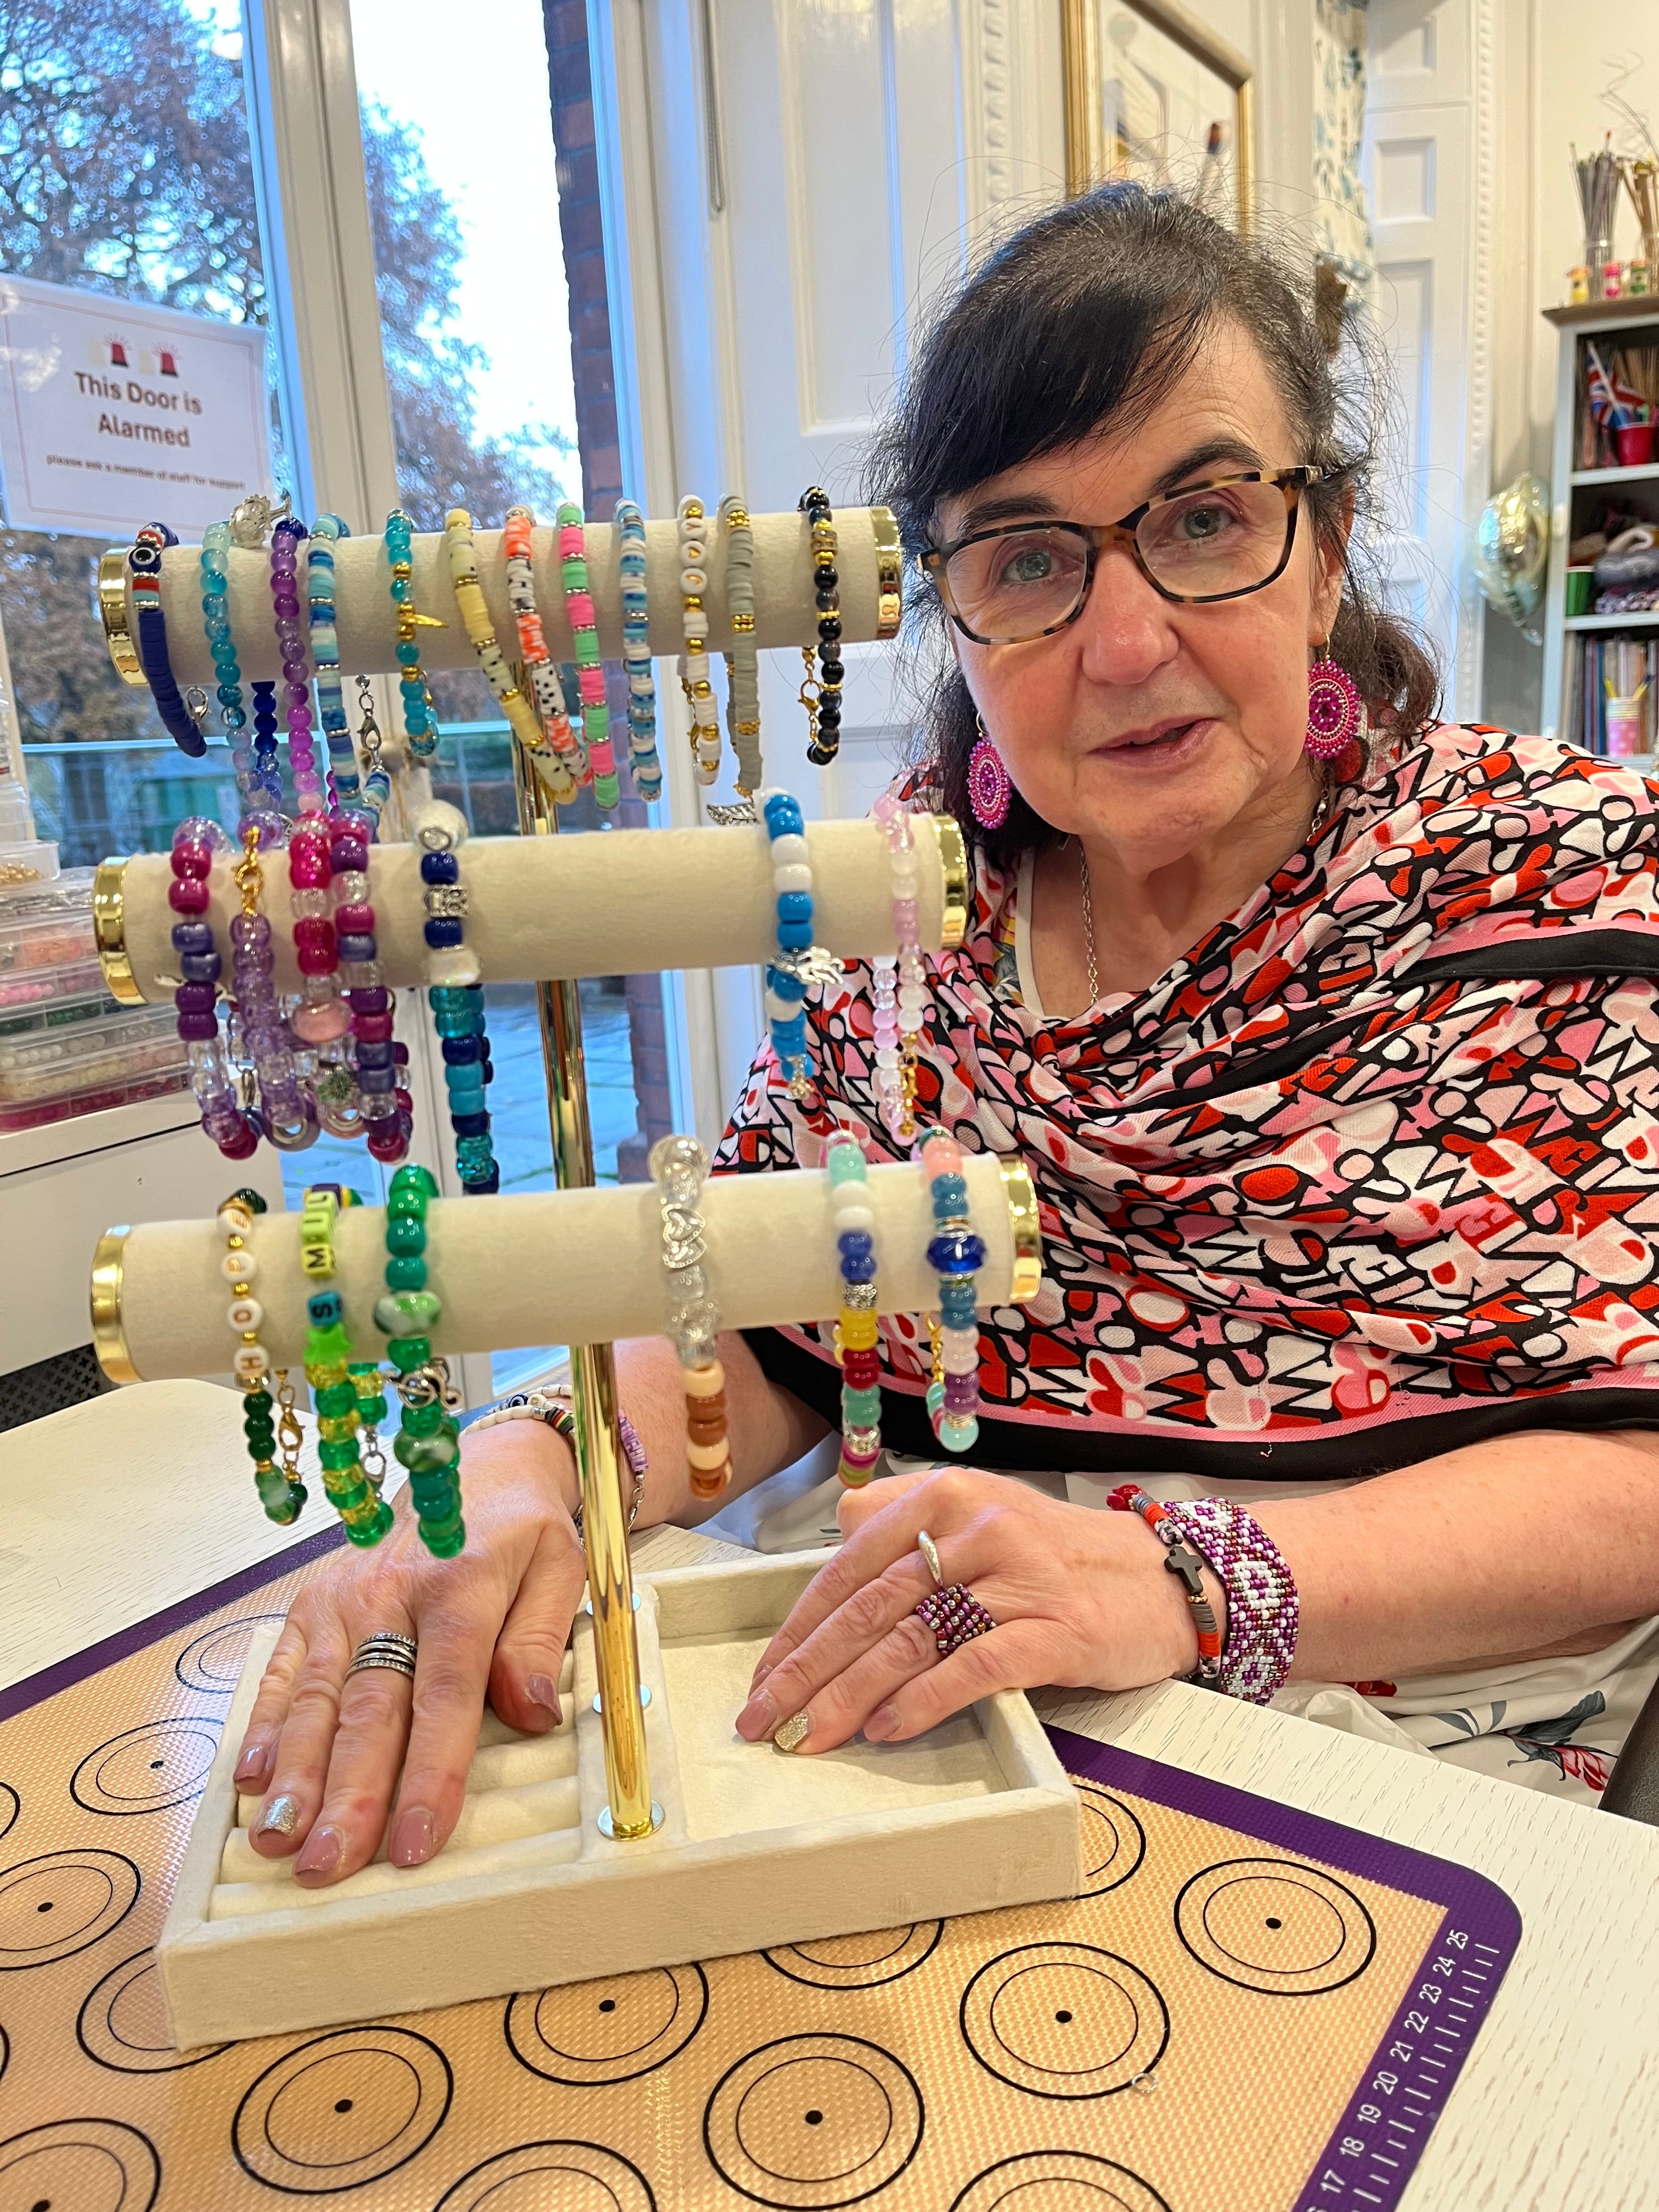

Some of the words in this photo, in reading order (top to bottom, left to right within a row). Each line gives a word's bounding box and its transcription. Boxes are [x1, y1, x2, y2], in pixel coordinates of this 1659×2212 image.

[74, 371, 121, 400] This
[127, 381, 179, 411] Door
[183, 391, 202, 414] is
[98, 413, 190, 448] Alarmed
[46, 454, 82, 468] please
[85, 459, 102, 471] ask
[113, 464, 154, 478] member
[156, 469, 167, 480] of
[169, 472, 191, 483] staff
[225, 1211, 264, 1371] HOPE
[1320, 2169, 1345, 2193] 17
[1339, 2136, 1365, 2158] 18
[1357, 2103, 1382, 2124] 19
[1373, 2070, 1399, 2095] 20
[1390, 2040, 1414, 2062] 21
[1403, 2011, 1430, 2033] 22
[1419, 1983, 1442, 2004] 23
[1432, 1956, 1457, 1977] 24
[1446, 1929, 1469, 1950] 25
